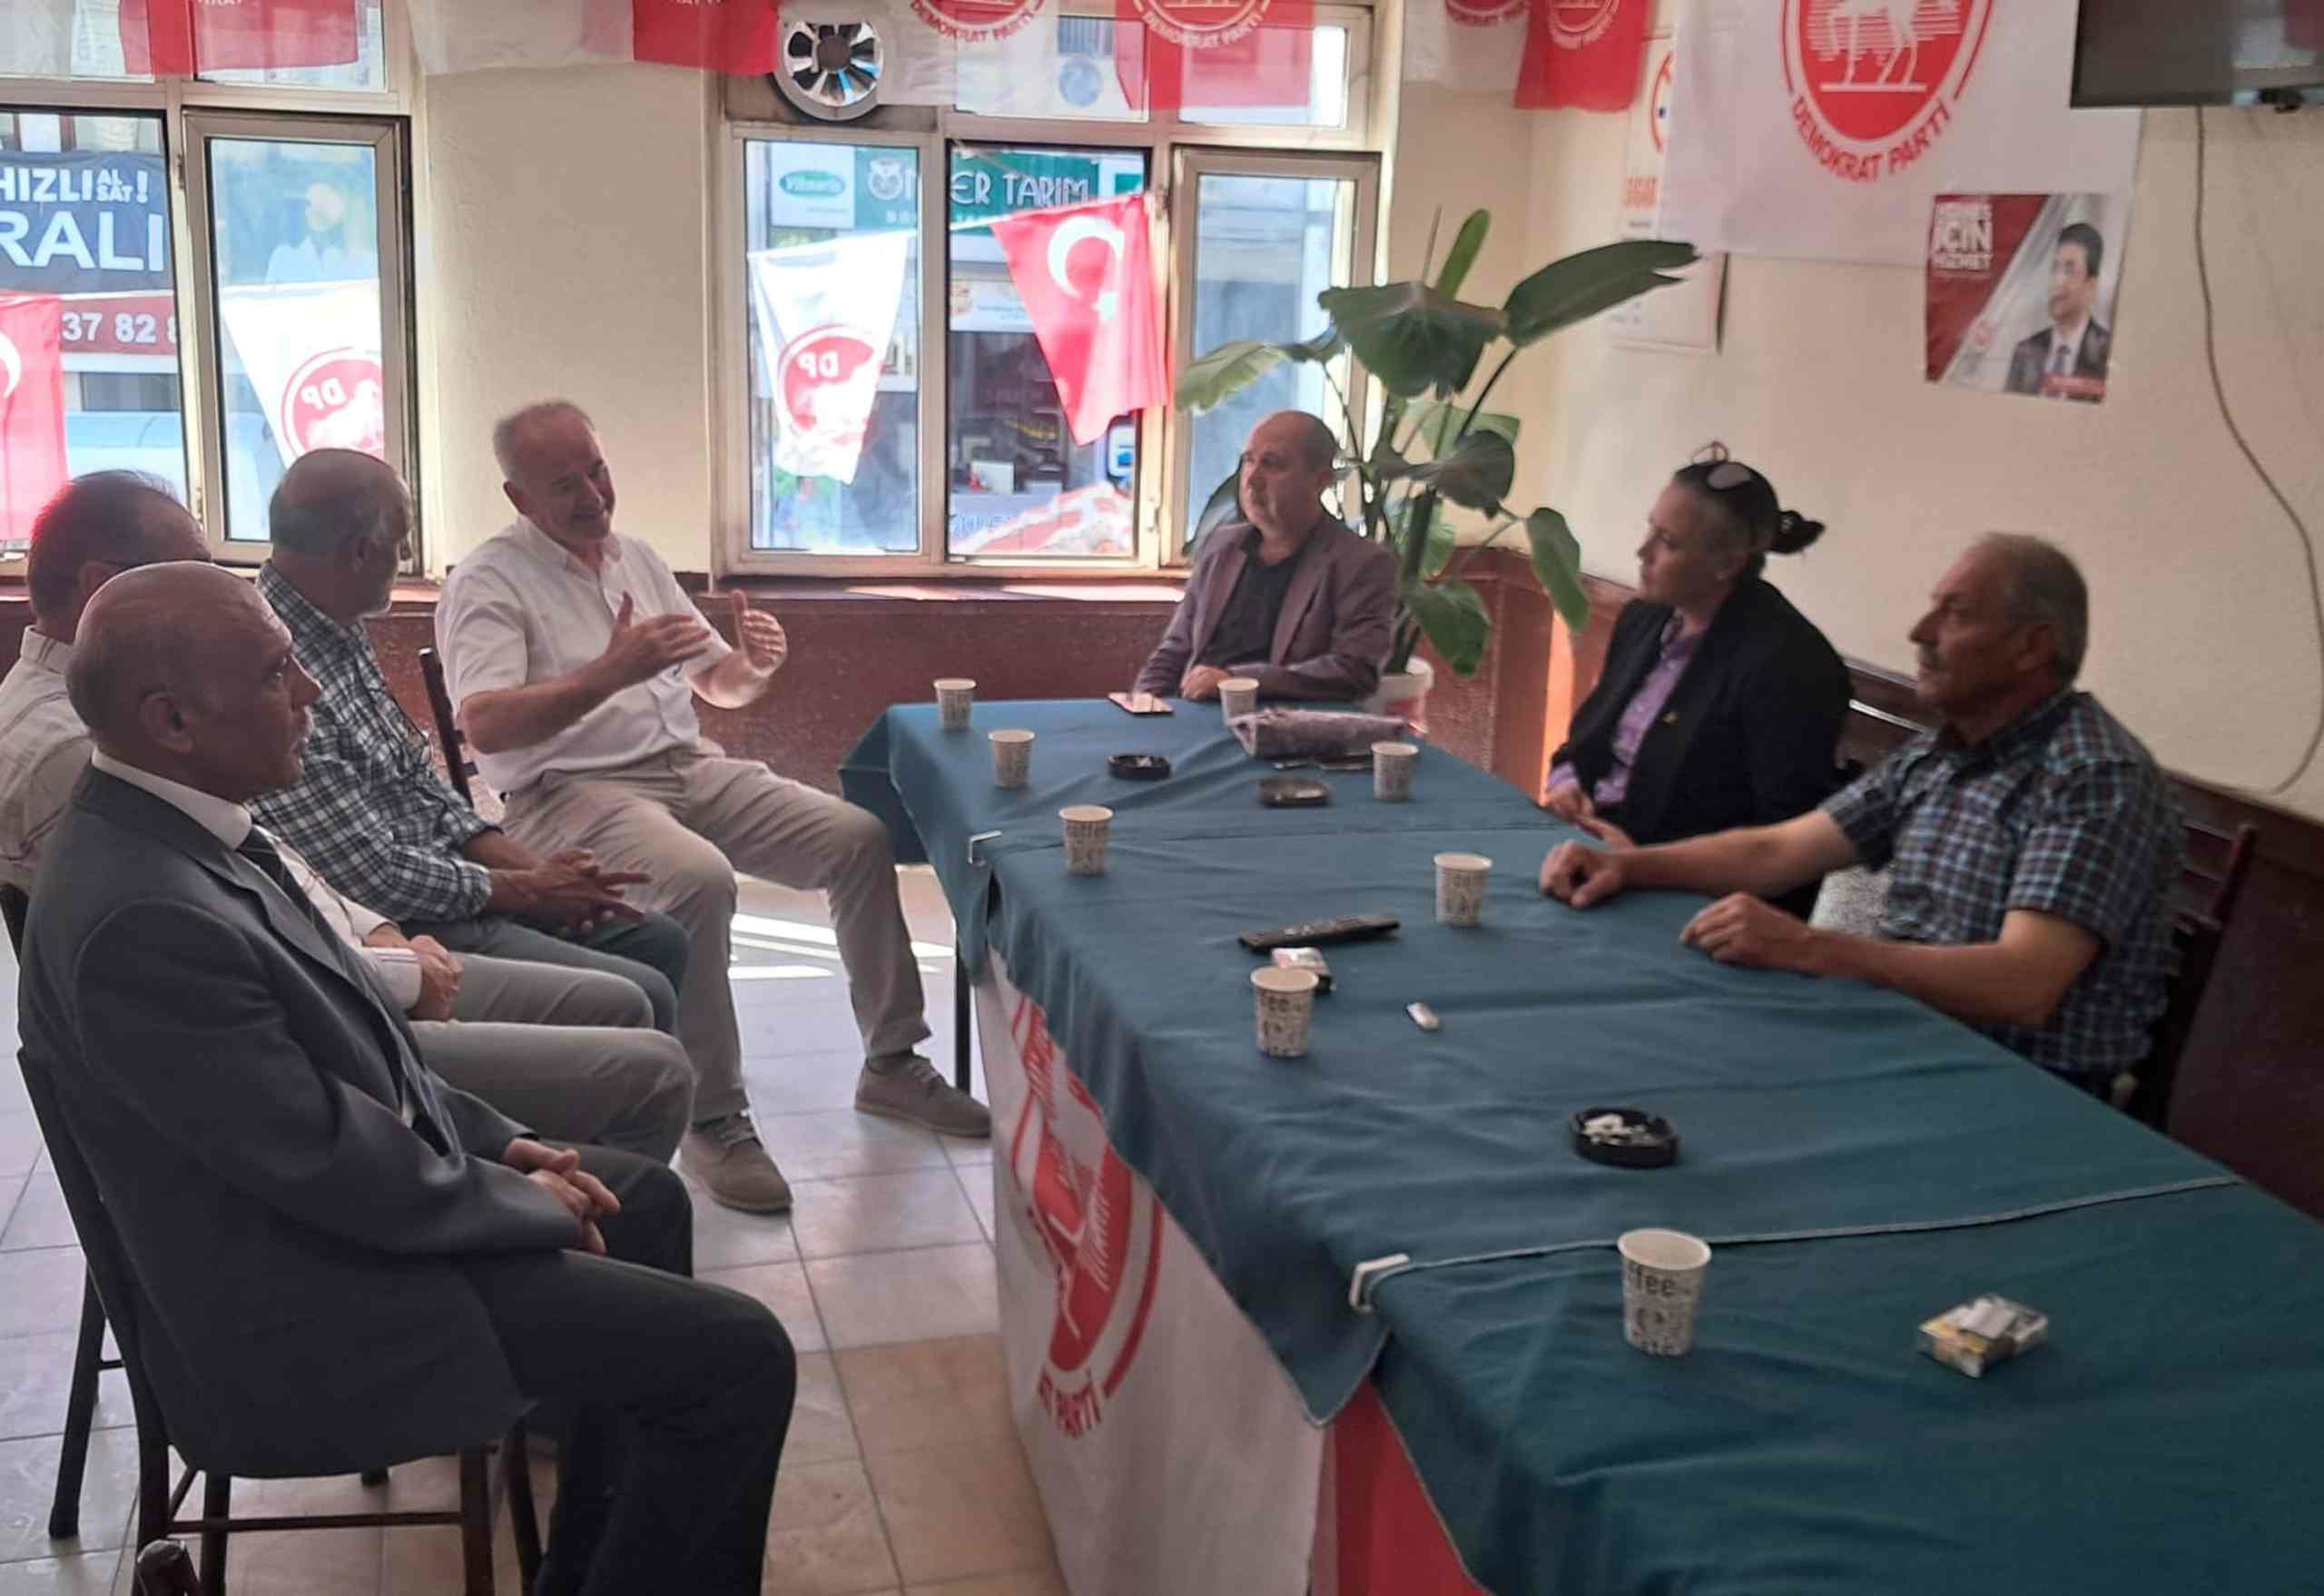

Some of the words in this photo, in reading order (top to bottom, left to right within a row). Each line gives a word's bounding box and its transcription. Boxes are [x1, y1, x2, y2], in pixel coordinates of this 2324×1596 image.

[1791, 94, 1883, 182] DEMOKRAT
[1002, 172, 1088, 208] TARIM
[62, 311, 103, 341] 37
[114, 312, 157, 343] 82
